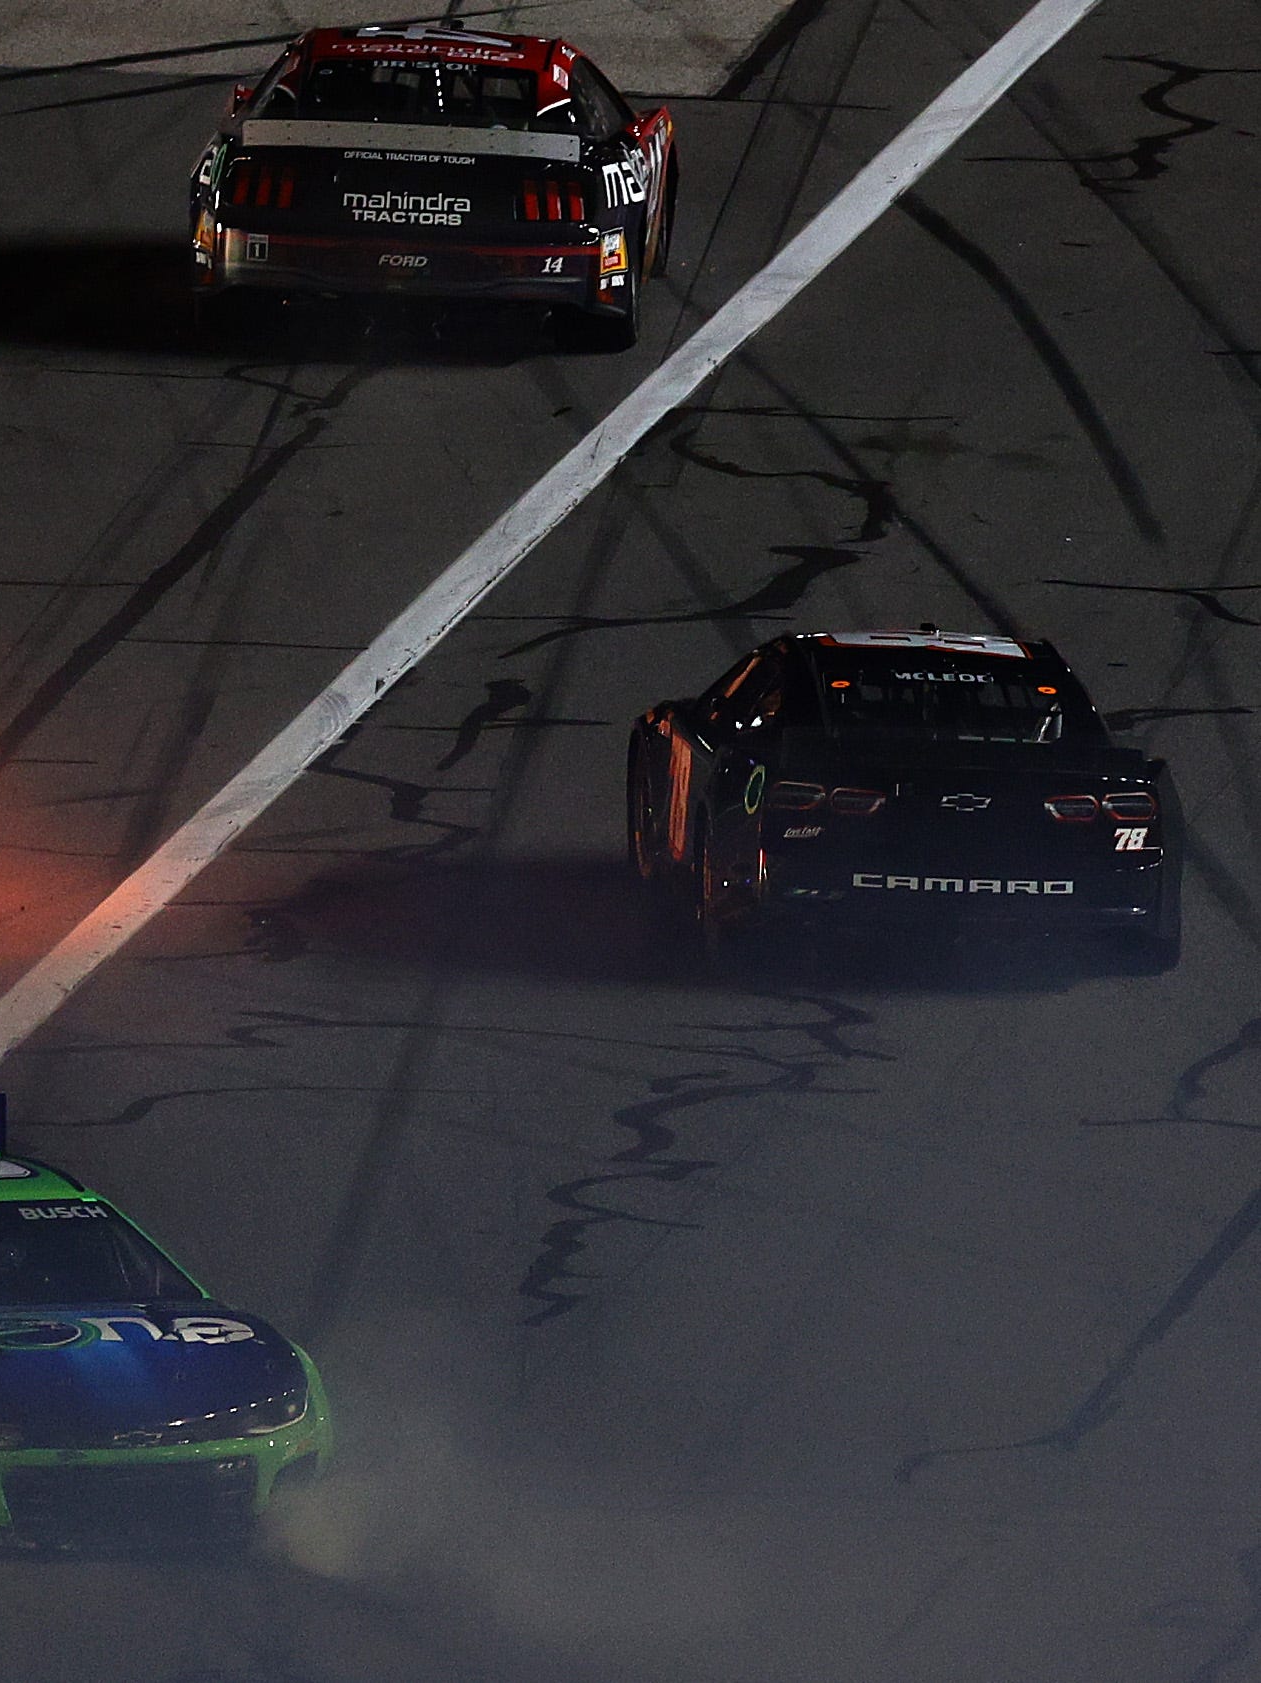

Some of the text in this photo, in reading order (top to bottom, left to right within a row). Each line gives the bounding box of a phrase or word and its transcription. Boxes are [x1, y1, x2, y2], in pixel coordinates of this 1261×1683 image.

[344, 151, 475, 165] OFFICIAL TRACTOR OF TOUGH
[342, 191, 471, 213] mahindra
[352, 209, 462, 226] TRACTORS
[378, 254, 428, 268] FORD
[541, 256, 564, 273] 14
[1114, 827, 1149, 851] 78
[852, 873, 1074, 895] CAMARO
[19, 1204, 108, 1221] BUSCH
